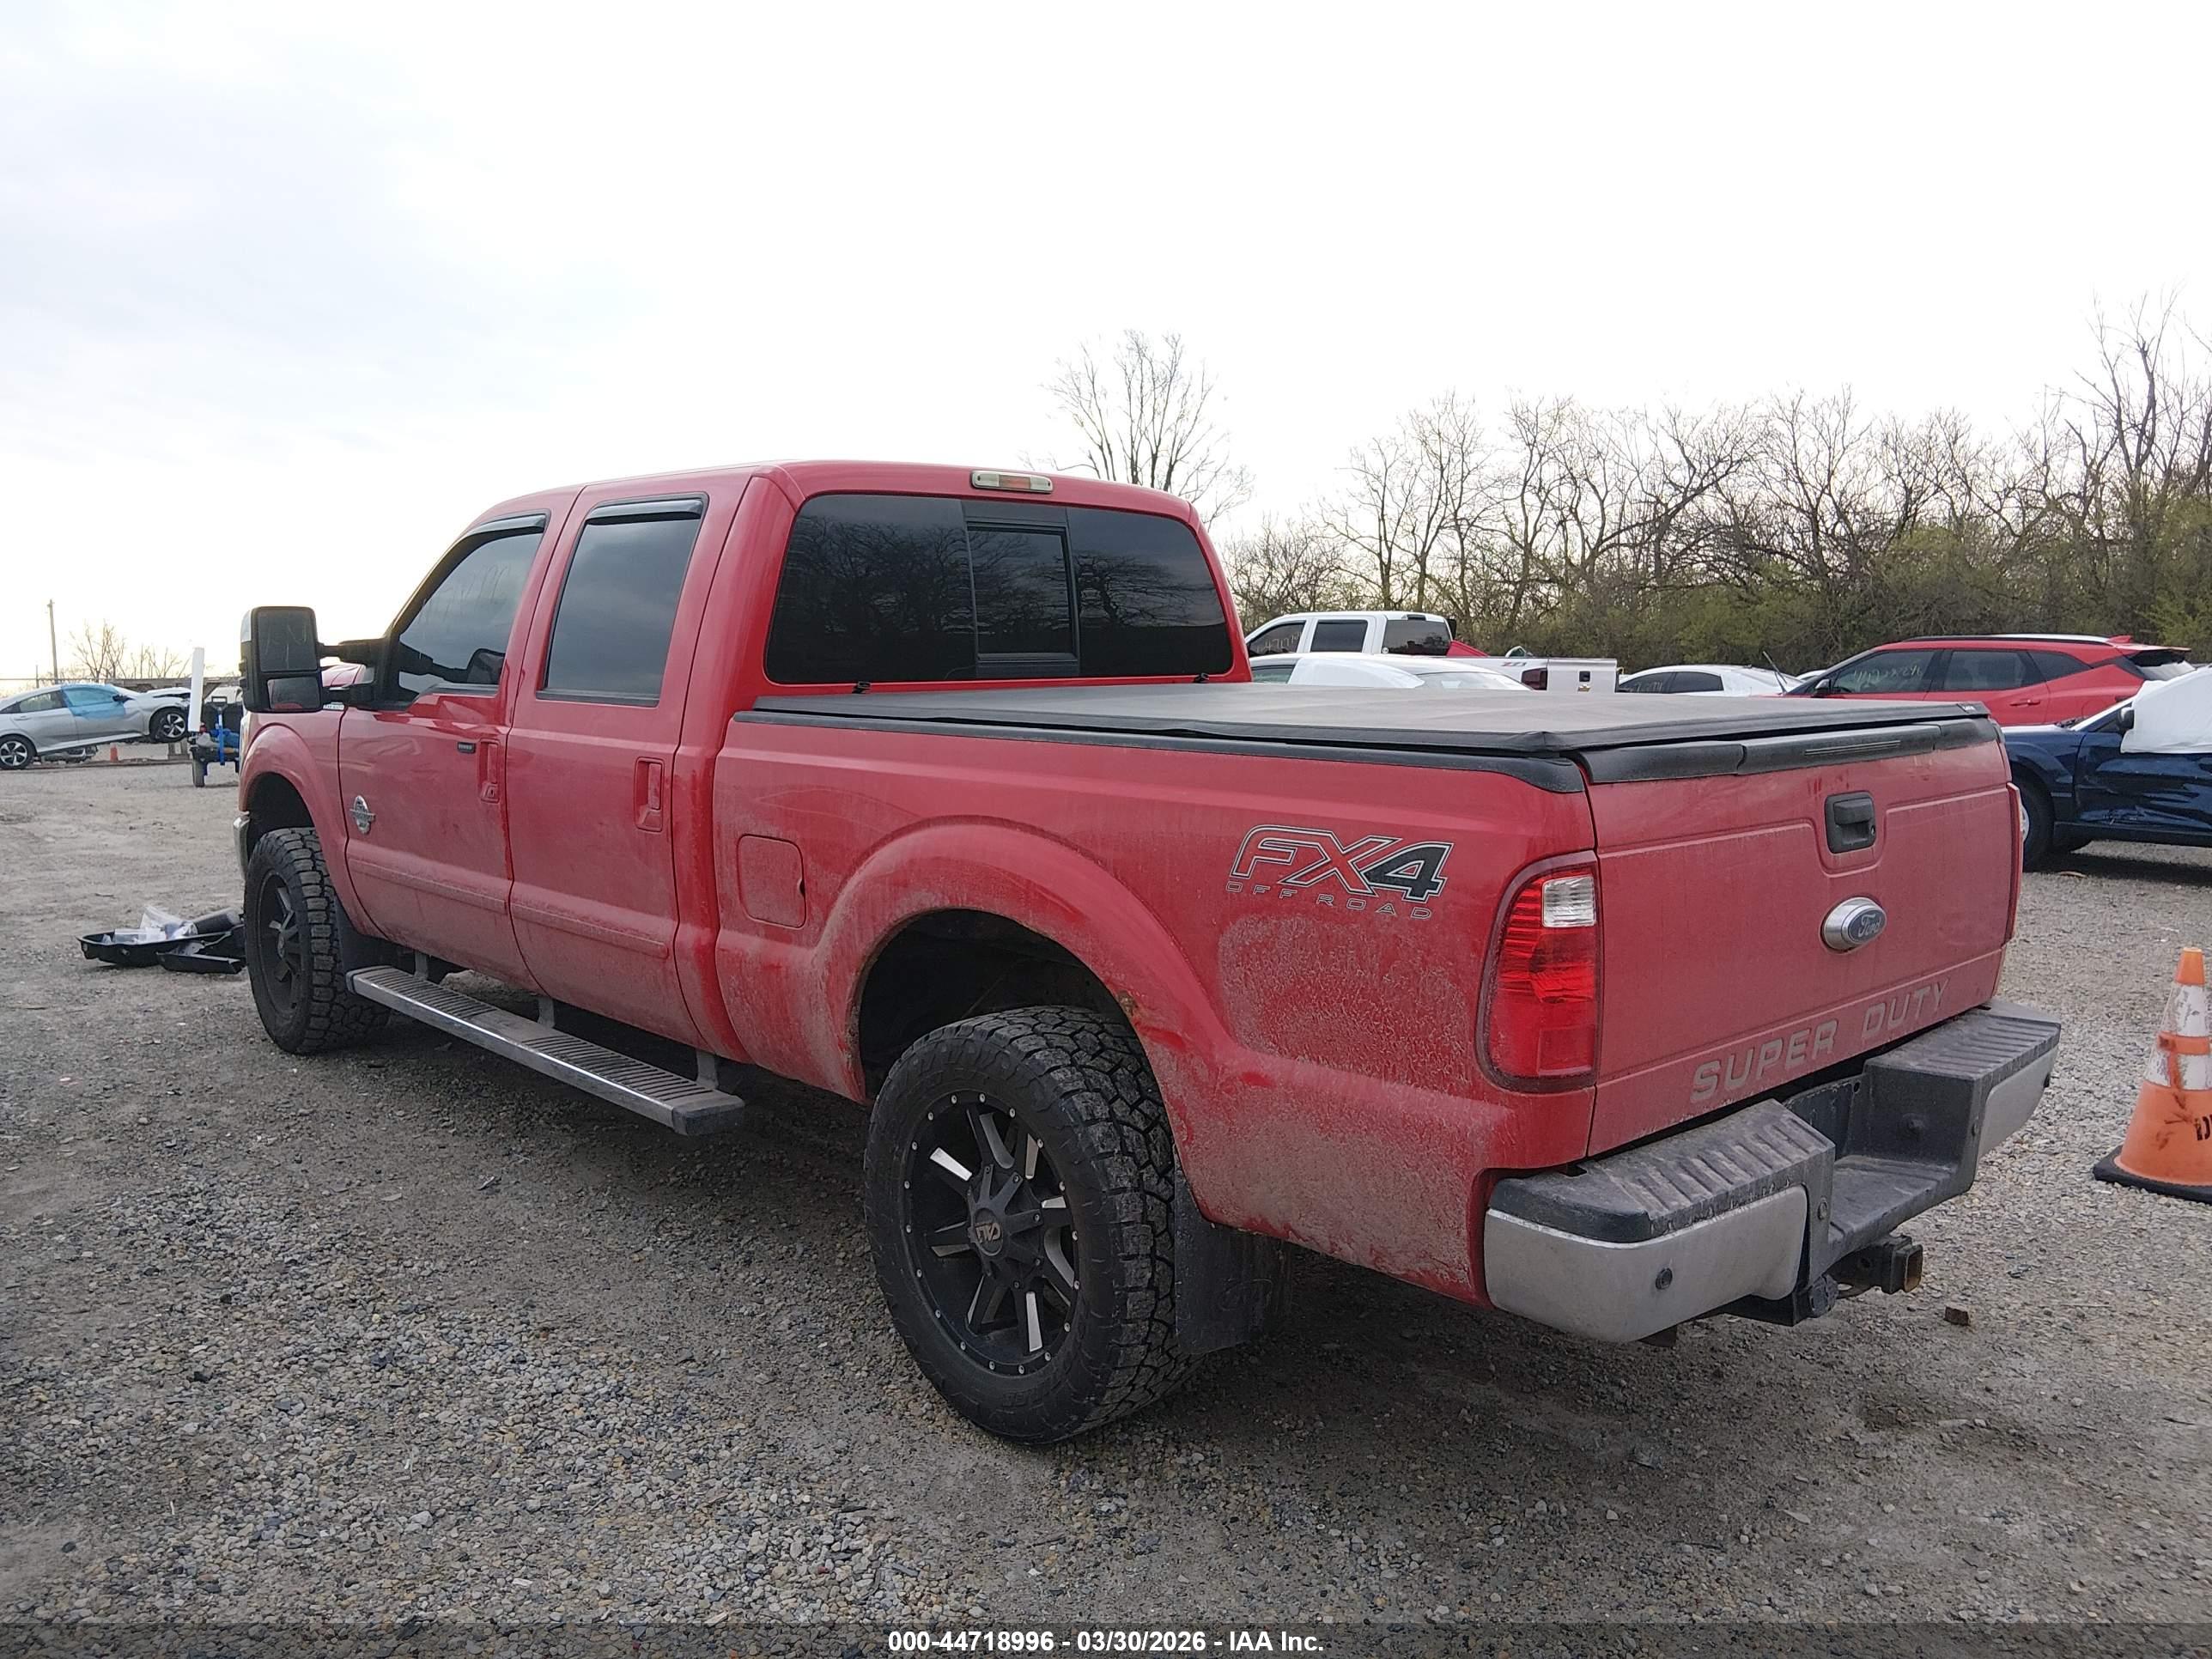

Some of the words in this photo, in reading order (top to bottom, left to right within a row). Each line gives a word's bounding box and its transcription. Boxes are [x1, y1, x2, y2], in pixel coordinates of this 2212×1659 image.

[1230, 824, 1454, 903] FX4
[1225, 880, 1297, 899] OFF
[1316, 894, 1432, 921] ROAD
[1857, 914, 1882, 938] Ford
[1690, 1018, 1838, 1103] SUPER
[1861, 977, 1950, 1040] DUTY
